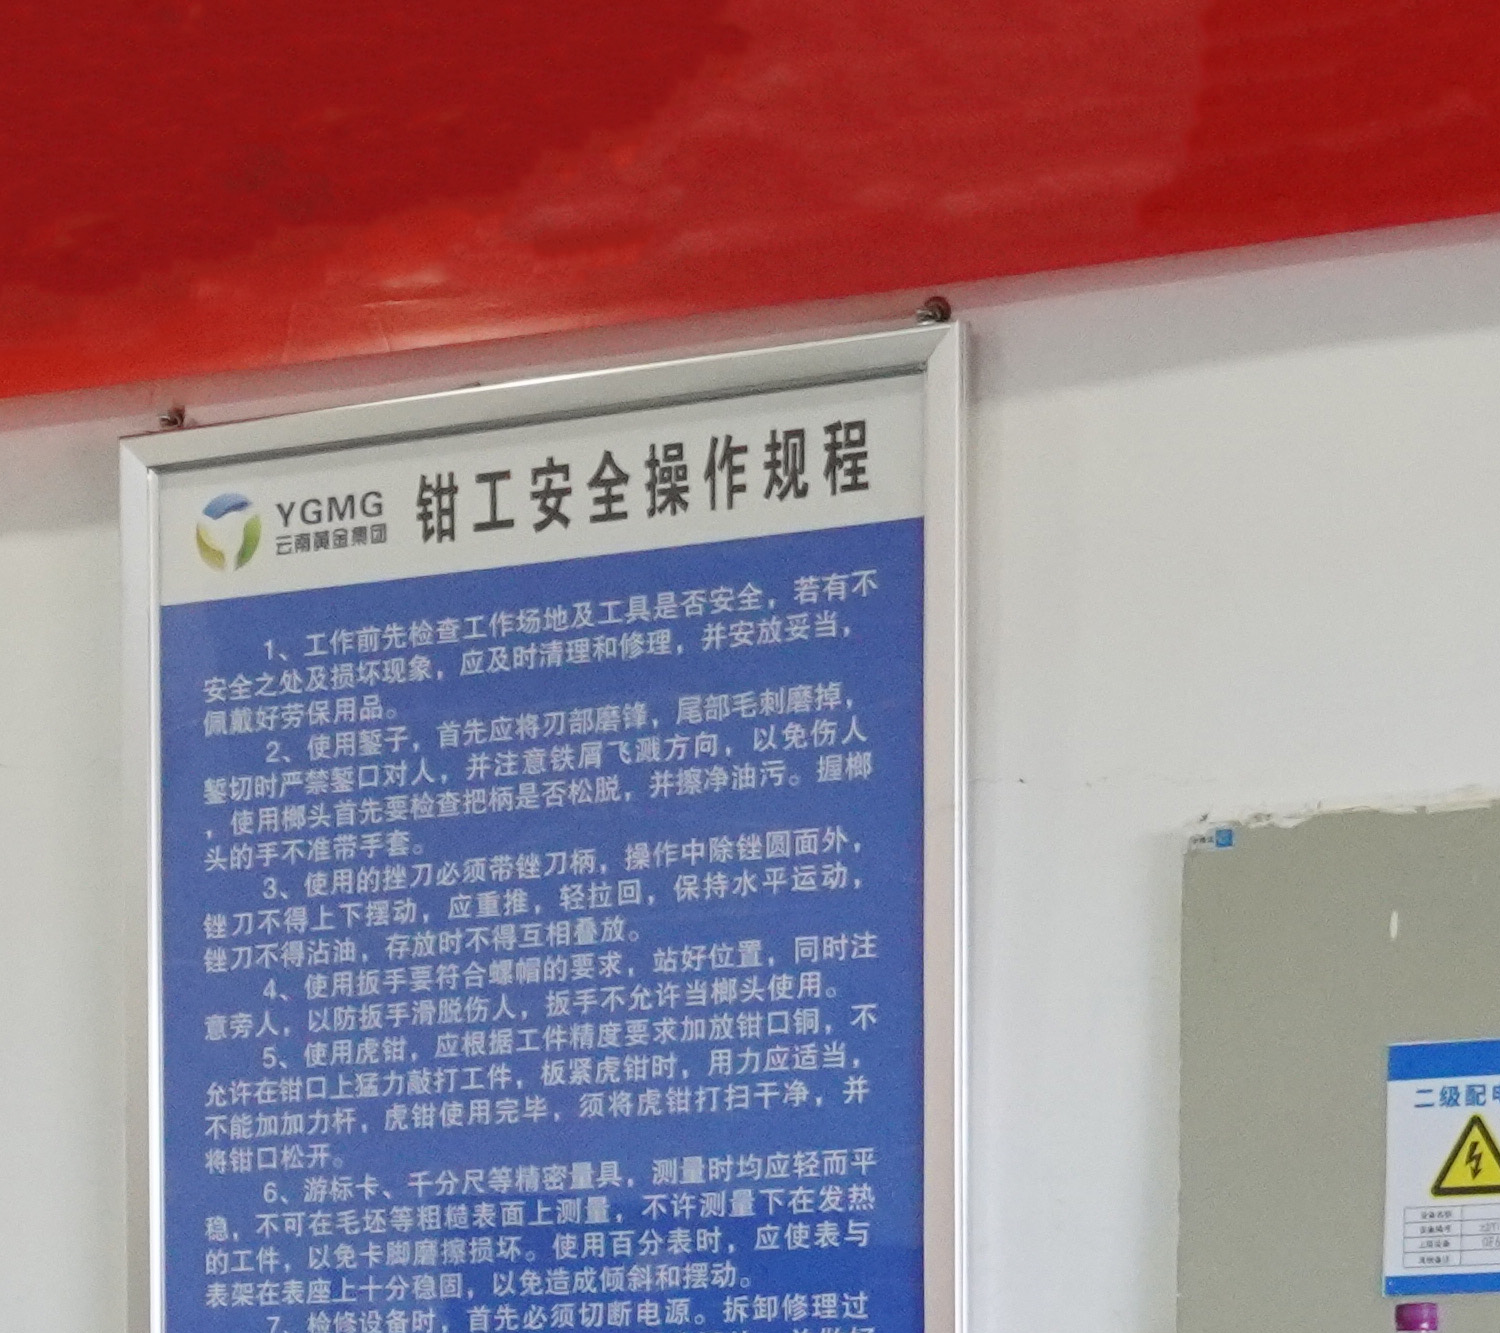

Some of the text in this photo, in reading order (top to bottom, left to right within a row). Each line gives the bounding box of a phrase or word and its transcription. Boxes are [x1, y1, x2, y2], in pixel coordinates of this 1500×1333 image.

[276, 490, 385, 527] YGMG
[416, 418, 872, 547] 钳工安全操作规程
[275, 522, 389, 557] 云南黄金集团
[264, 569, 878, 661] 1、工作前先检查工作场地及工具是否安全，若有不
[203, 610, 853, 703] 安全之处及损坏现象，应及时清理和修理，并安放妥当，
[203, 694, 397, 737] 佩戴好劳保用品。
[204, 829, 424, 872] 头的手不准带手套。
[263, 931, 878, 1002] 4、使用扳手要符合螺帽的要求，站好位置，同时注
[204, 971, 839, 1041] 意旁人，以防扳手滑脱伤人，扳手不允许当榔头使用。
[205, 1143, 345, 1174] 将钳口松开。
